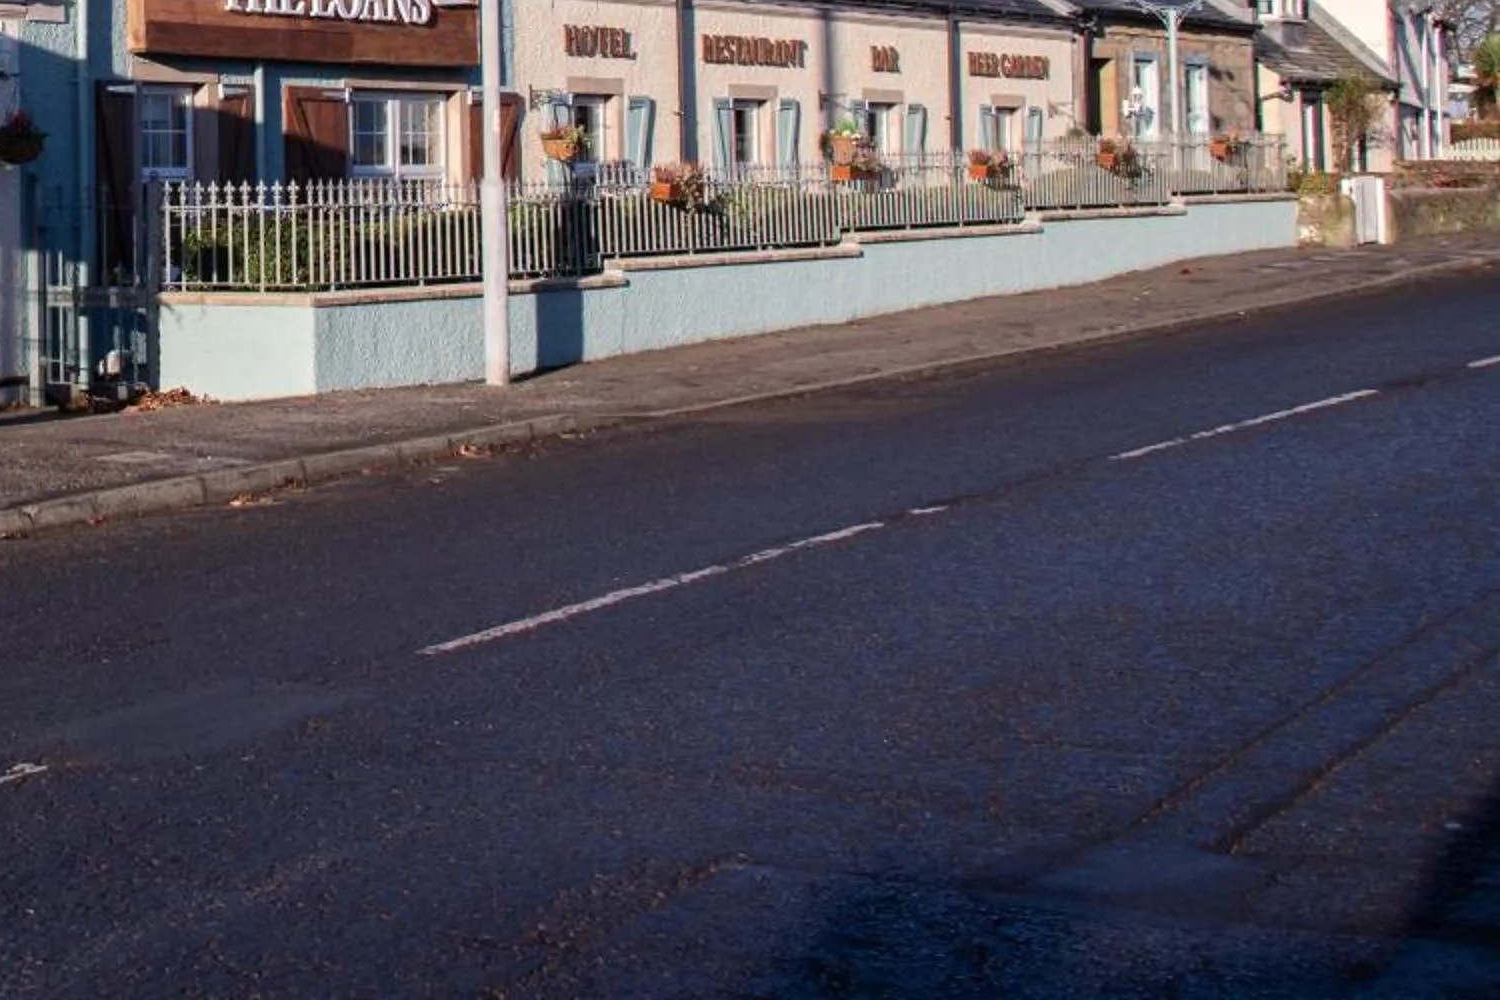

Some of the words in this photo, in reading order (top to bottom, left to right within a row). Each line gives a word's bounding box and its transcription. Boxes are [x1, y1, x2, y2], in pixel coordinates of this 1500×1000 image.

[563, 23, 637, 61] HOTEL
[701, 33, 808, 69] RESTAURANT
[870, 45, 901, 74] BAR
[968, 51, 1000, 78] BEER
[1001, 53, 1051, 81] GARDEN
